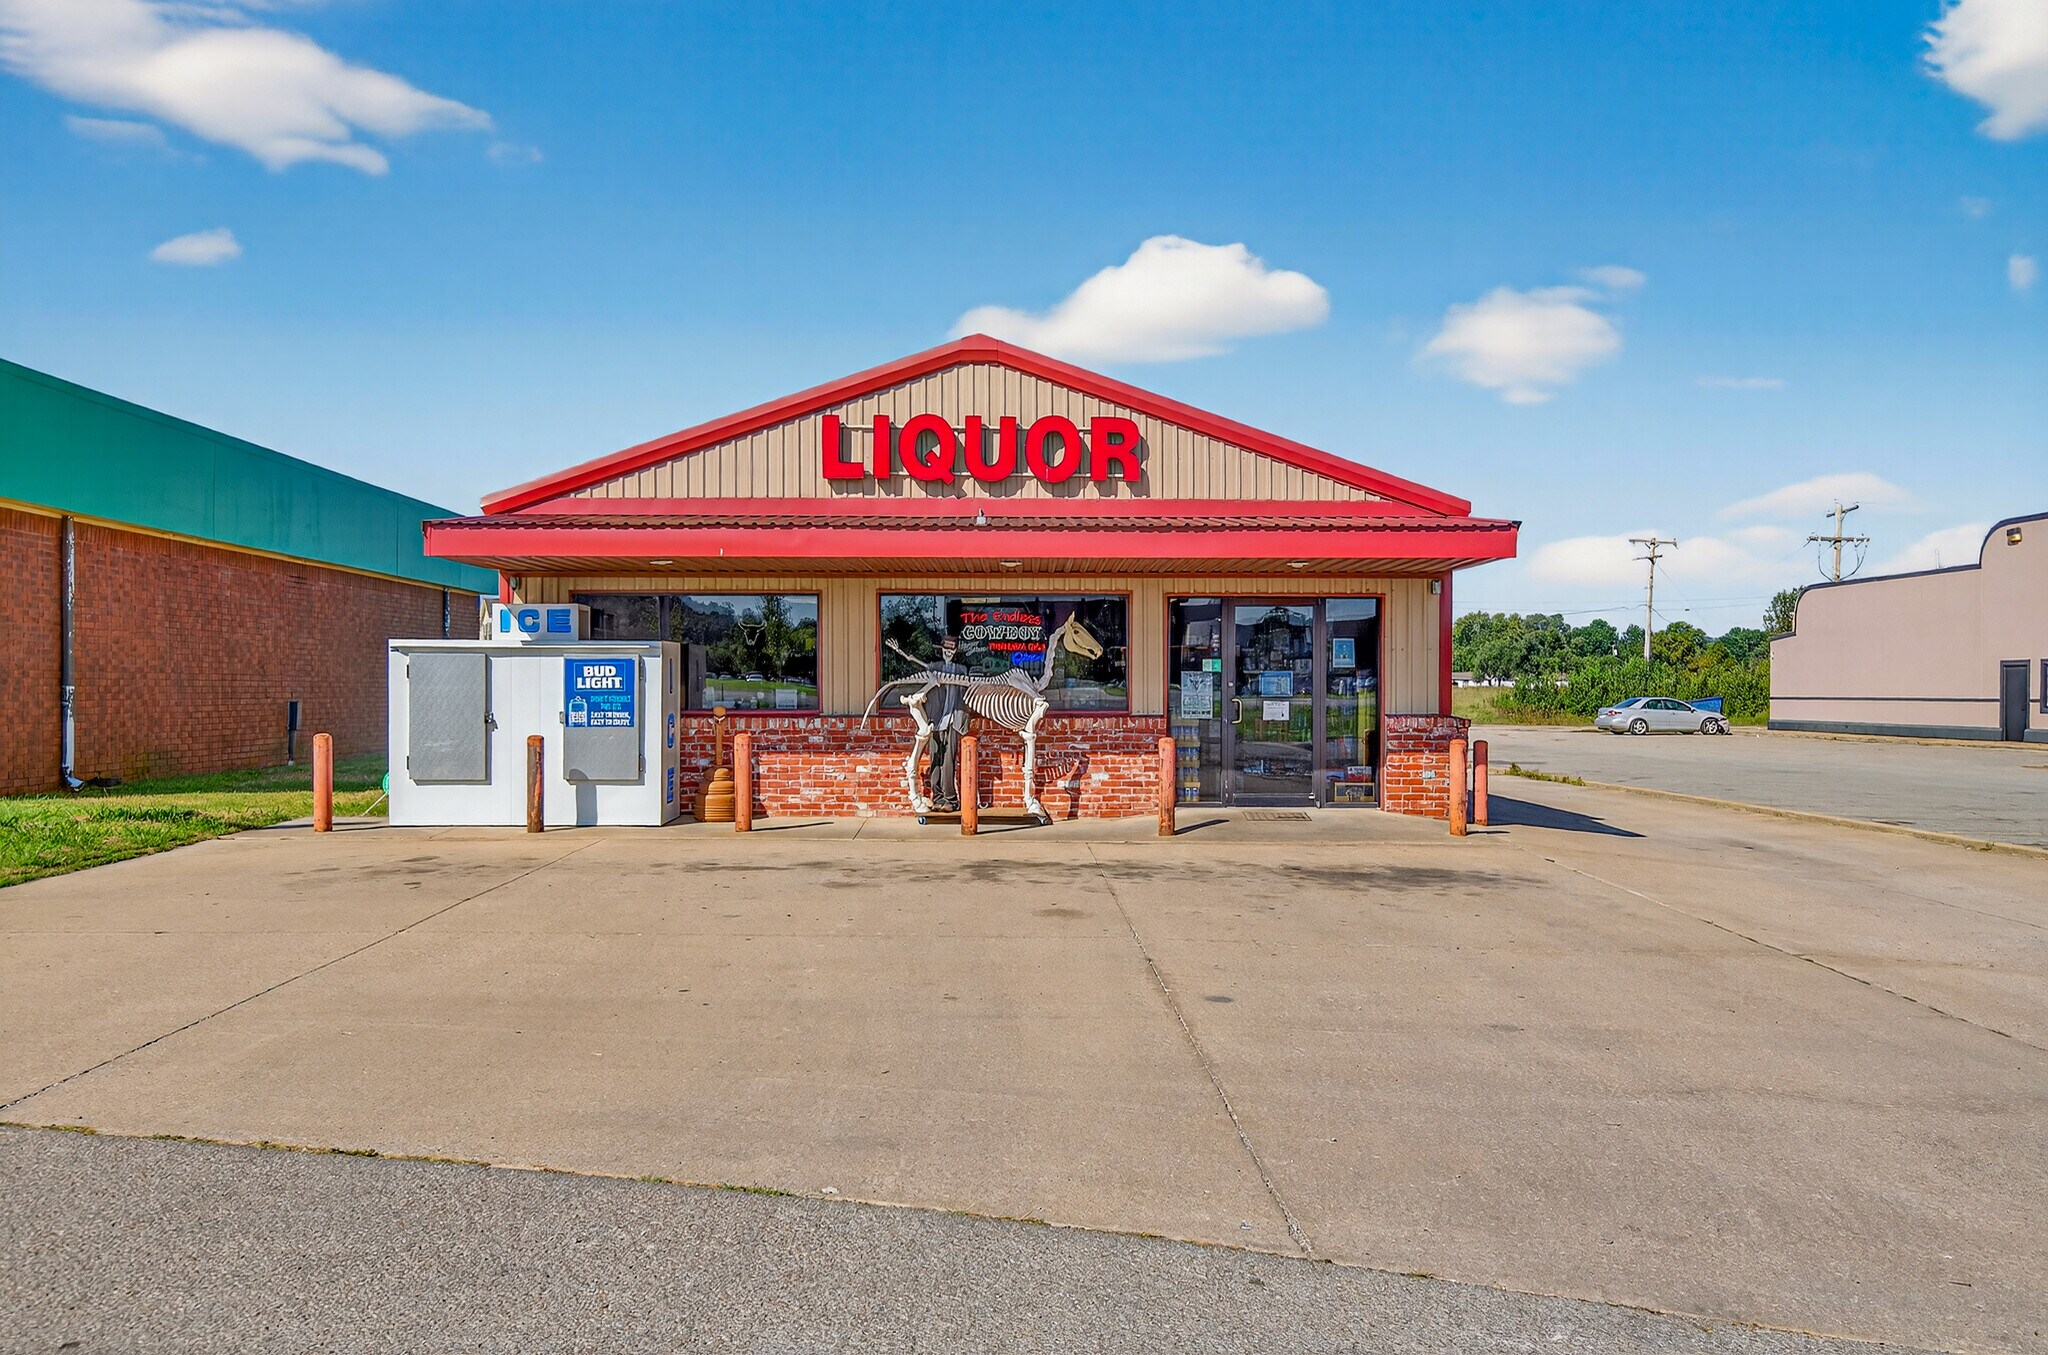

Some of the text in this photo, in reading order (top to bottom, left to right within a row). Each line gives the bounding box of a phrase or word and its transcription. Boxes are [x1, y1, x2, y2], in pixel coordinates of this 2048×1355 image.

[822, 413, 1141, 485] LIQUOR
[500, 608, 572, 633] ICE
[962, 625, 1043, 641] COWBOY
[583, 665, 617, 677] BUD
[576, 677, 623, 689] LIGHT
